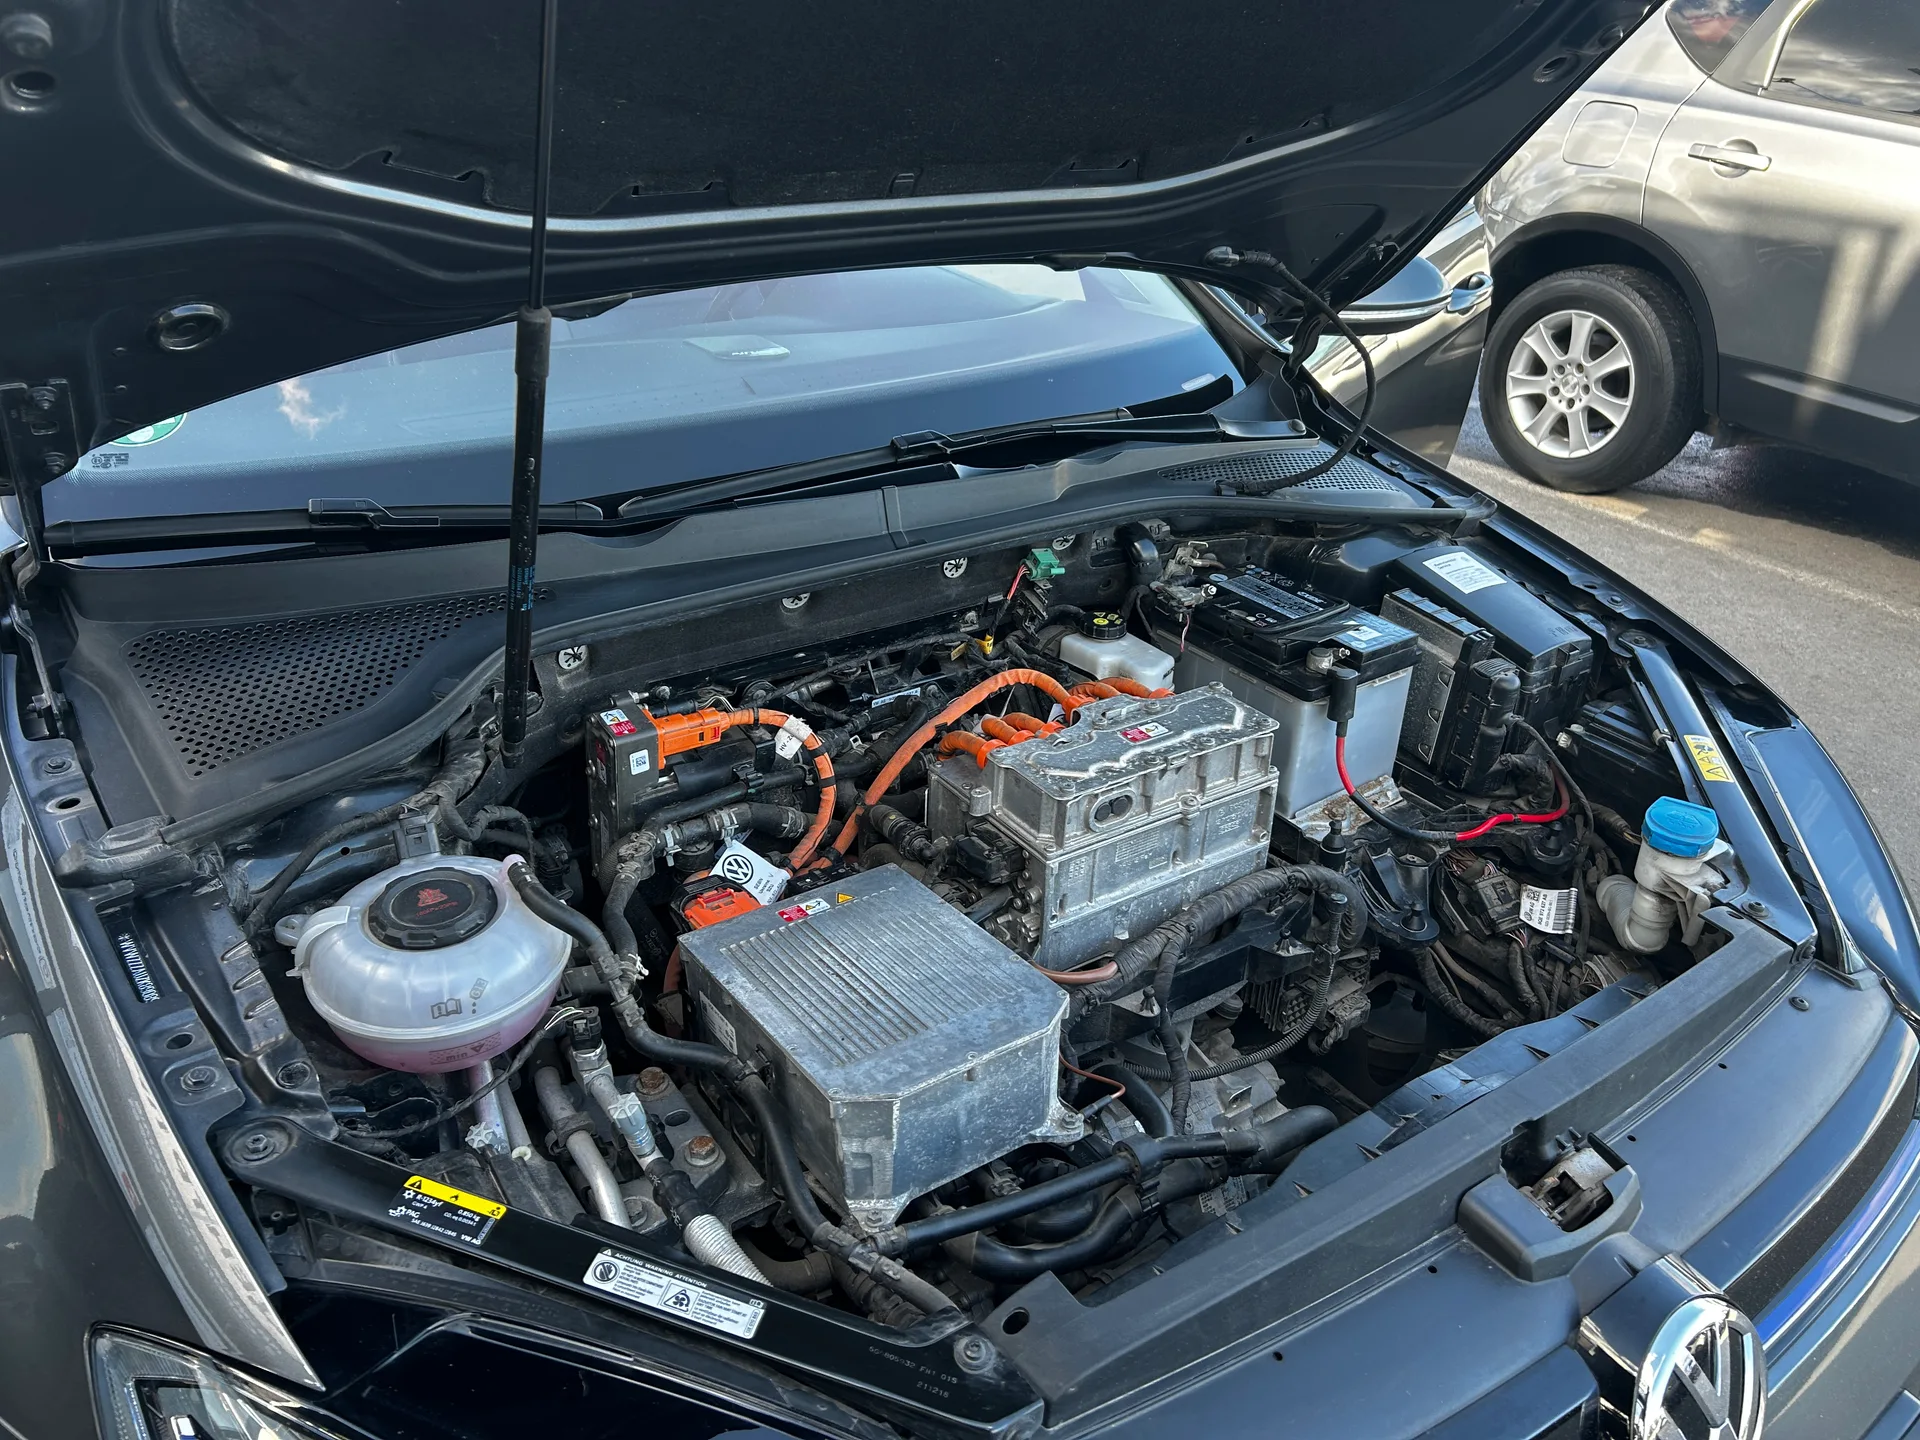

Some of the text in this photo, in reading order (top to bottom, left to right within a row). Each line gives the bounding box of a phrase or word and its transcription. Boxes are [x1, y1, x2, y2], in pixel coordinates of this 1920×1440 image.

[446, 1052, 467, 1060] min
[416, 1194, 444, 1207] R-1234yf
[406, 1209, 420, 1218] PAG
[461, 1234, 472, 1242] VW
[614, 1252, 707, 1288] ACHTUNG WARNING ATTENTION
